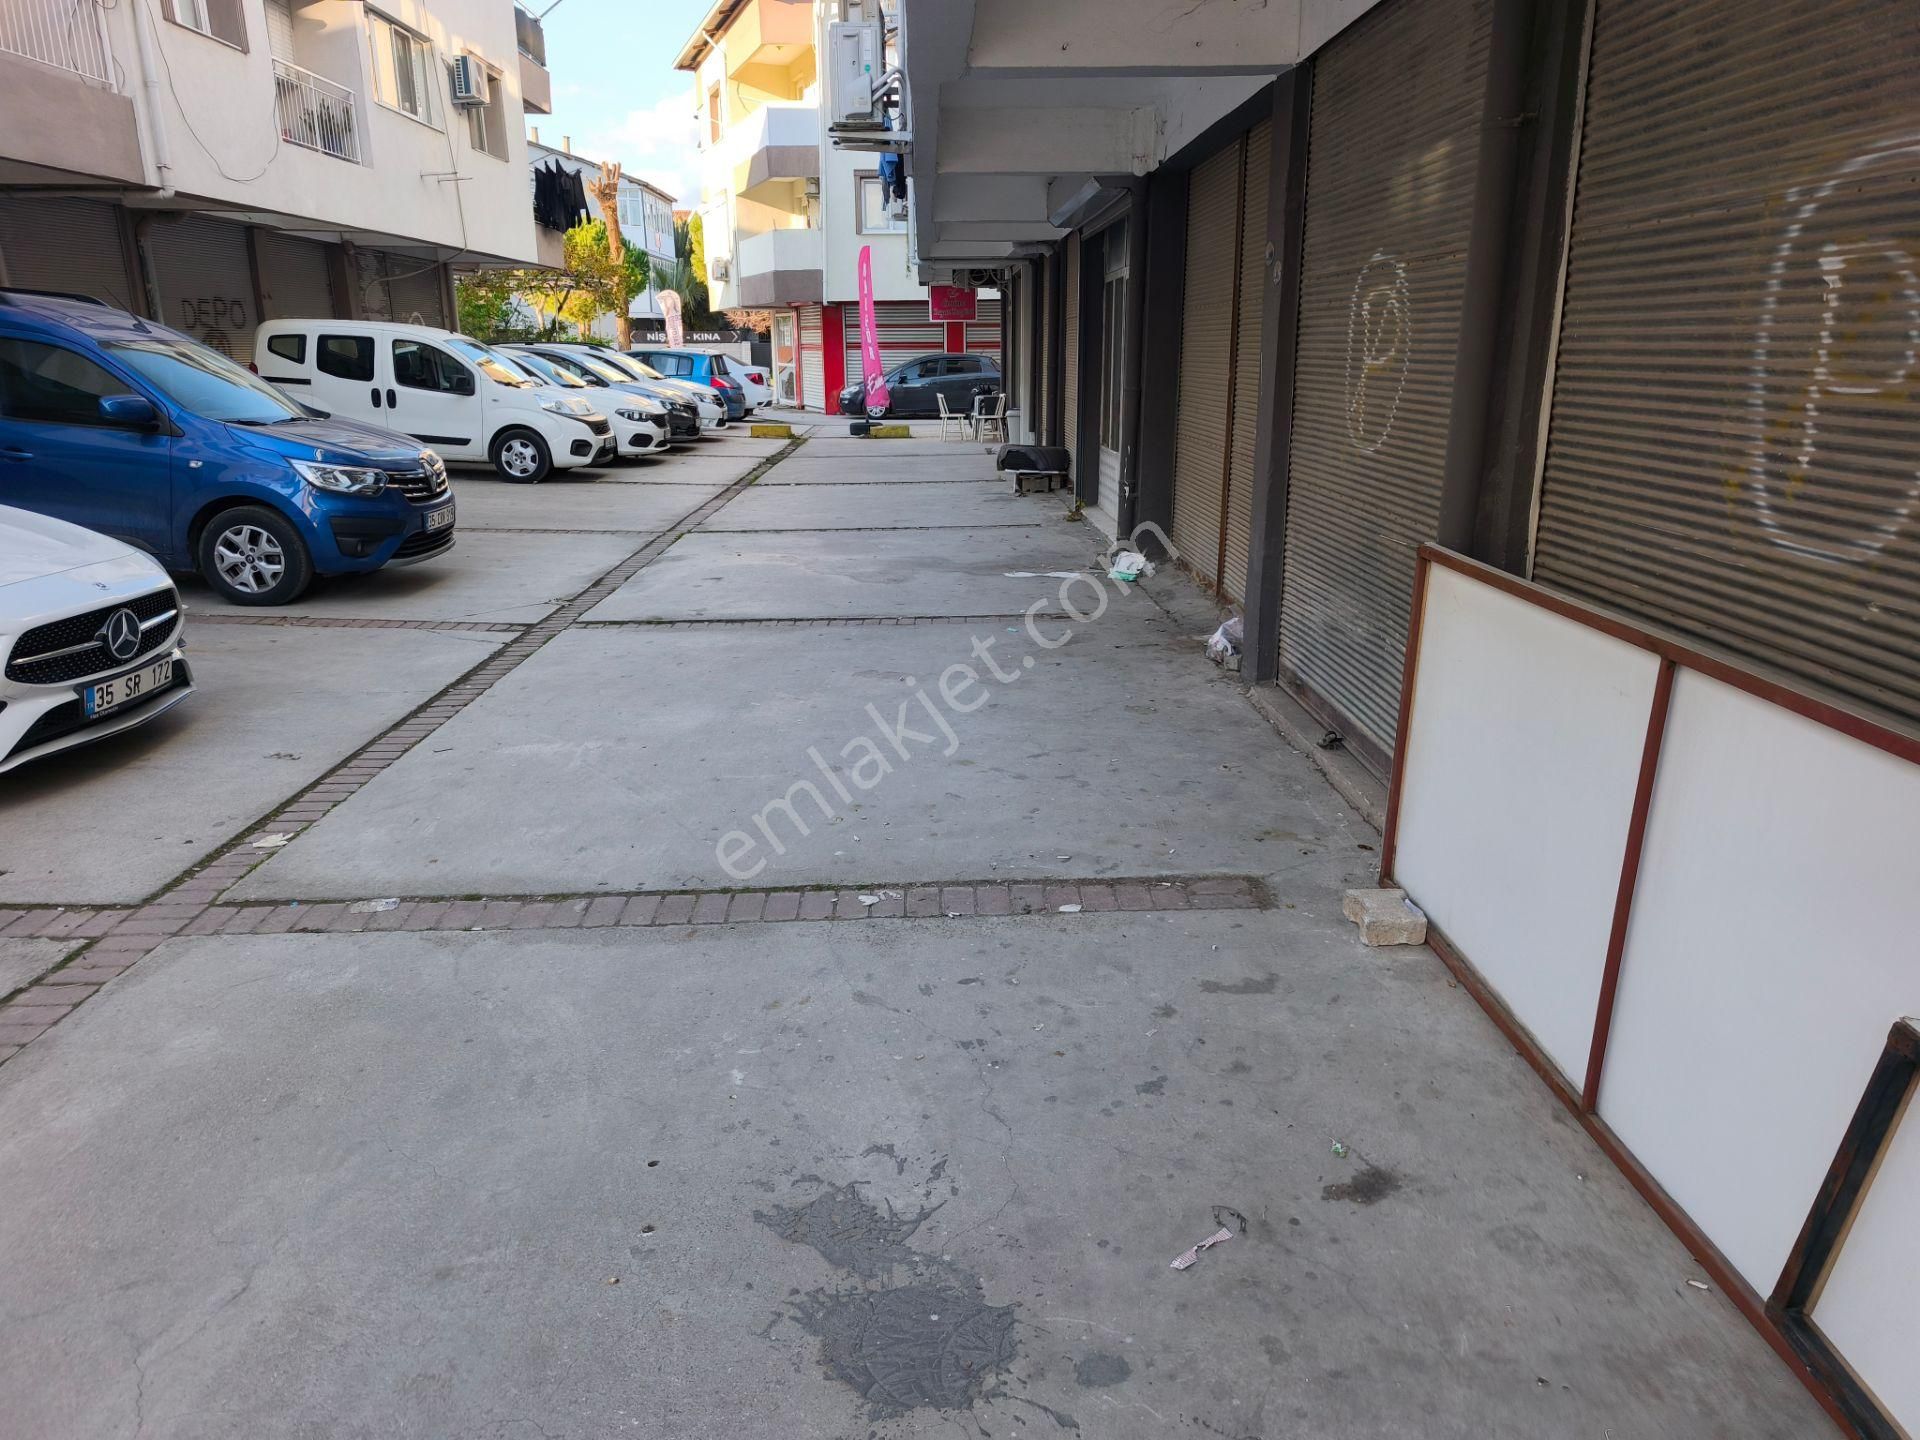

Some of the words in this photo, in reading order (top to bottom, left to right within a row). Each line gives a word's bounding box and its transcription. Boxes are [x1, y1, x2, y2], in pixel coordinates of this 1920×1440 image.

[181, 297, 246, 330] DEPO
[693, 333, 720, 341] KINA
[96, 684, 114, 708] 35
[125, 674, 141, 698] SR
[152, 661, 170, 686] 172
